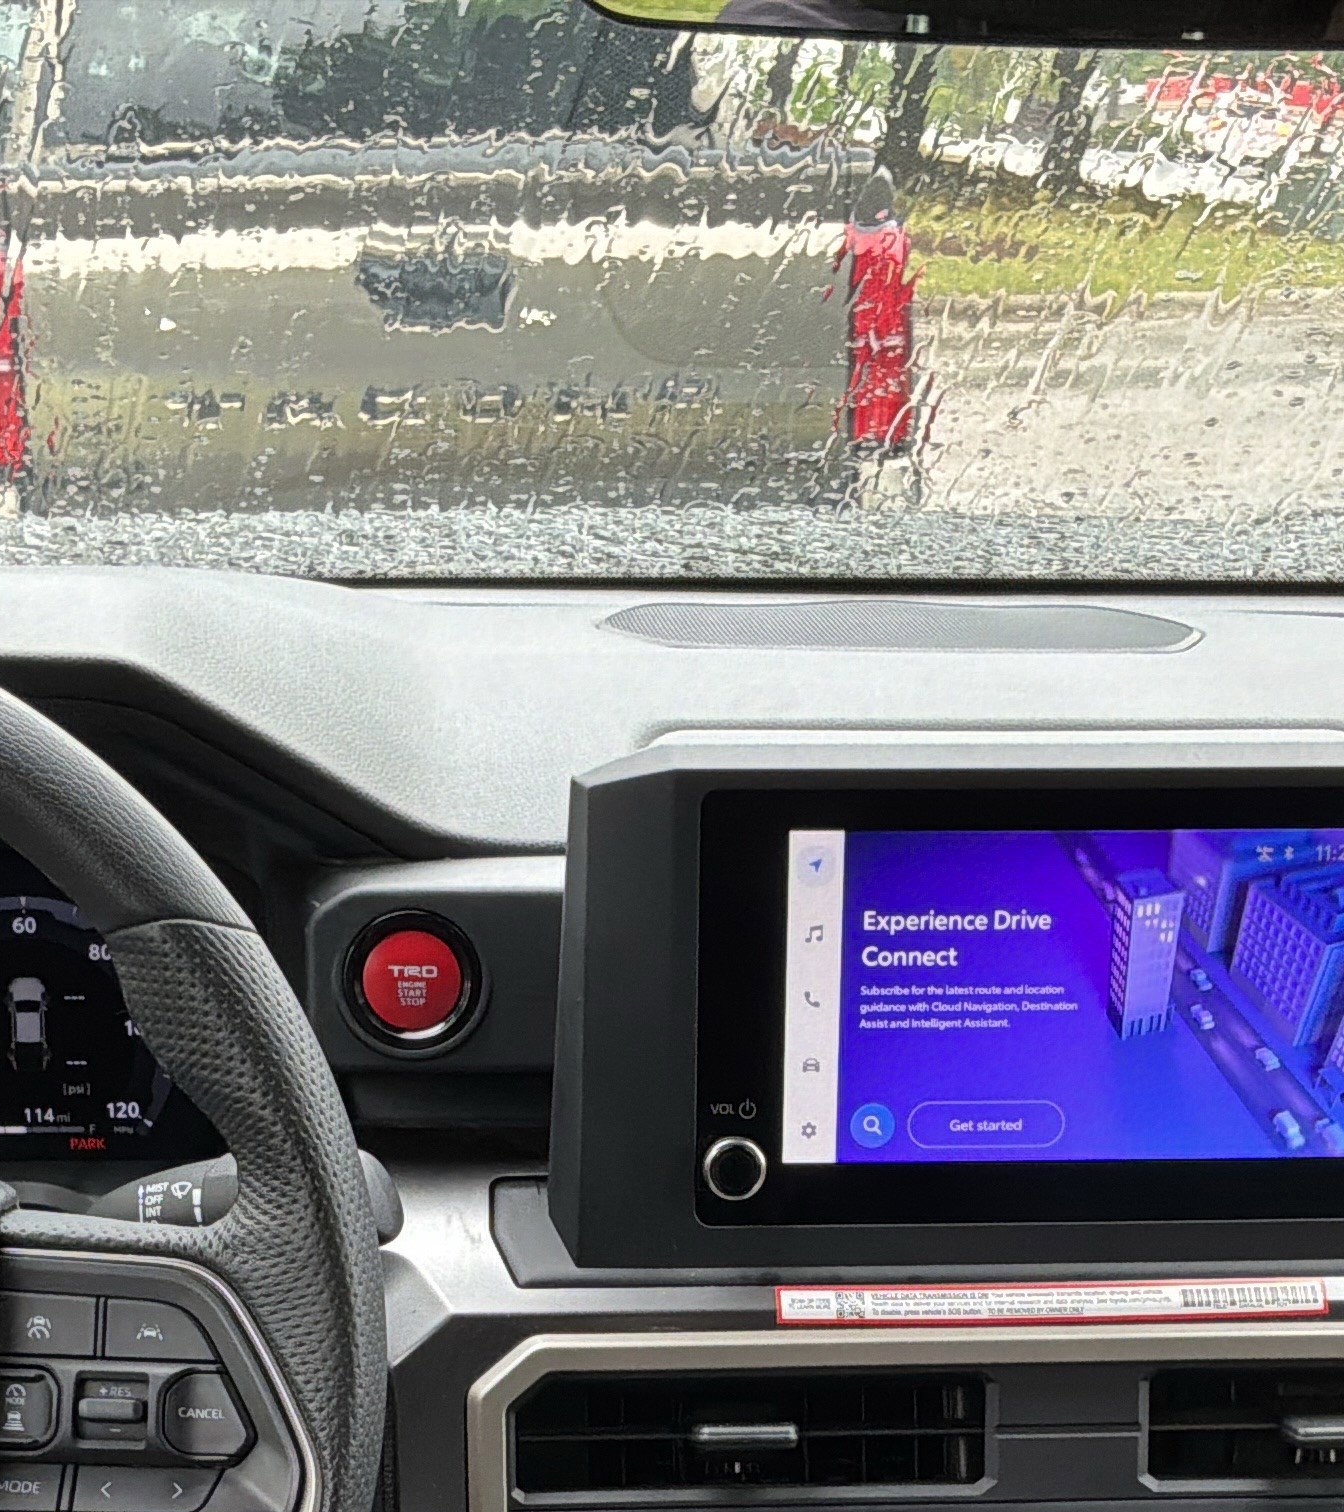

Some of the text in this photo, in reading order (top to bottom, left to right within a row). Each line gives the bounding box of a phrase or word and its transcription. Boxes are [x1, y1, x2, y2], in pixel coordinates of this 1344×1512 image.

[12, 917, 37, 934] 60
[863, 909, 1053, 935] Experience Drive
[88, 944, 112, 961] 80
[861, 946, 958, 967] Connect
[388, 965, 438, 978] TRD
[398, 989, 427, 997] START
[860, 984, 1065, 995] Subscribe for the latest route and location
[400, 998, 426, 1006] STOP
[859, 1001, 1078, 1014] guidance with Cloud Navigation, Destination
[859, 1018, 1011, 1031] Assist and Intelligent Assistant.
[24, 1107, 71, 1123] 114 mi
[106, 1102, 140, 1119] 120
[711, 1102, 734, 1116] VOL
[949, 1117, 1023, 1134] Get started
[70, 1138, 105, 1151] PARK
[146, 1182, 169, 1193] MIST
[145, 1194, 163, 1206] OFF
[146, 1206, 161, 1218] INT
[178, 1407, 225, 1420] CANCEL
